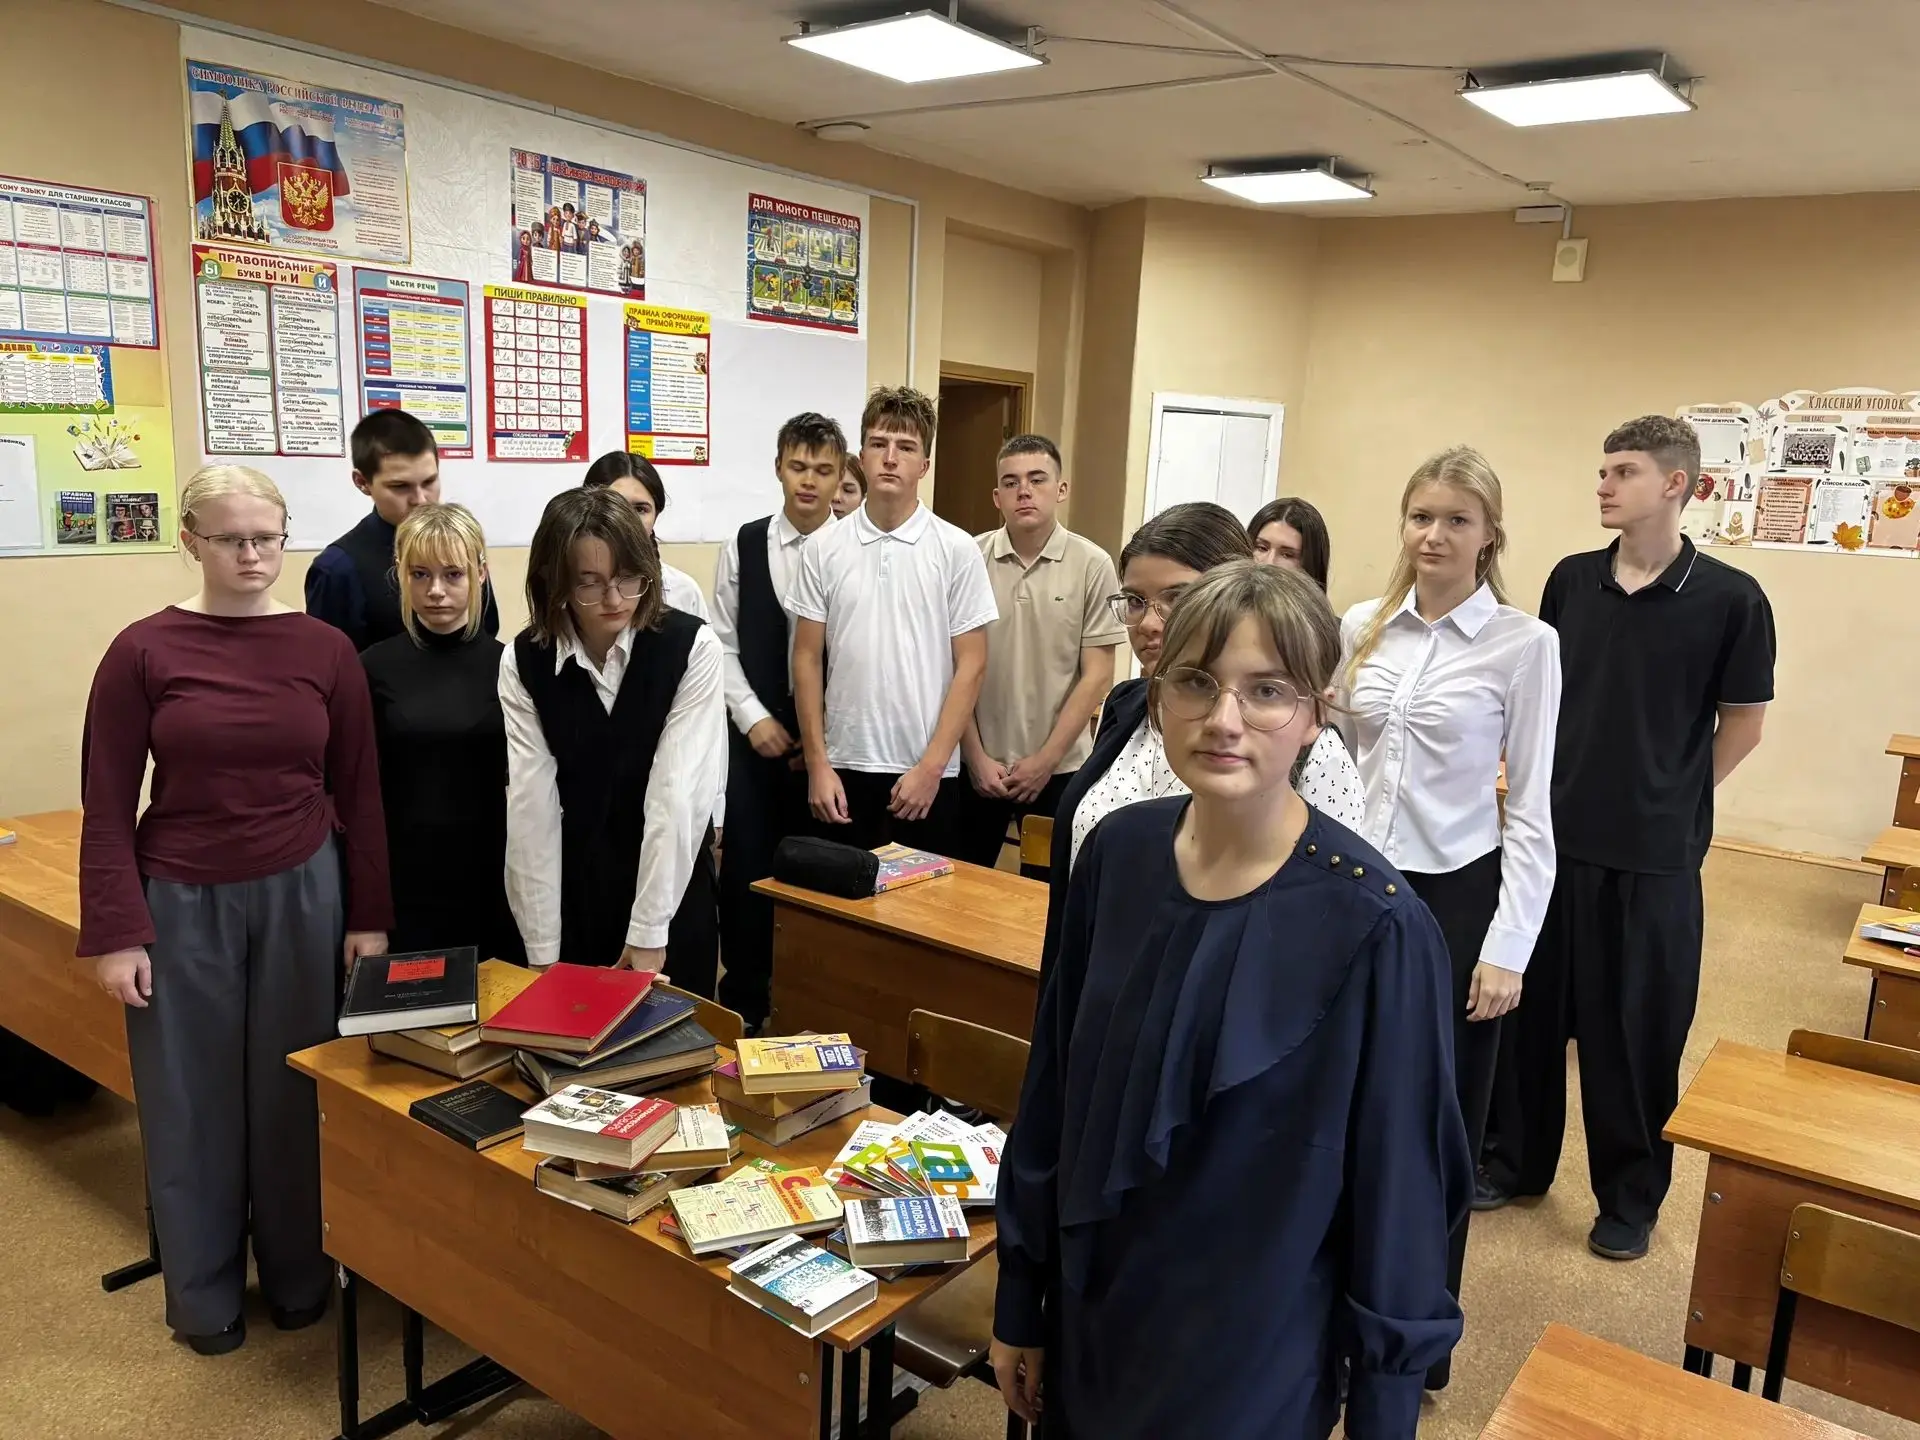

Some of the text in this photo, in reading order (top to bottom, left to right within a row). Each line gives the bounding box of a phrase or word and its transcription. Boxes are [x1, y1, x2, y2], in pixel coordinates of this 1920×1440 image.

[191, 66, 264, 92] СИМВОЛИКА
[266, 81, 339, 107] РОССИЙСКОЙ
[20, 186, 46, 196] ЯЗЫКУ
[65, 192, 99, 203] СТАРШИХ
[100, 198, 131, 208] КЛАССОВ
[752, 198, 859, 230] ДЛЯ ЮНОГО ПЕШЕХОДА
[204, 263, 218, 276] Ы
[218, 253, 315, 274] ПРАВОПИСАНИЕ
[237, 269, 262, 279] БУКВ
[265, 270, 277, 281] Ы
[290, 273, 299, 284] И
[318, 277, 327, 288] И
[389, 279, 436, 291] ЧАСТИ РЕЧИ
[494, 288, 577, 305] ПИШИ ПРАВИЛЬНО
[629, 307, 705, 323] ПРАВИЛА ОФОРМЛЕНИЯ
[646, 318, 691, 330] ПРЯМОЙ РЕЧИ
[907, 1200, 930, 1234] СЛОВАРЬ
